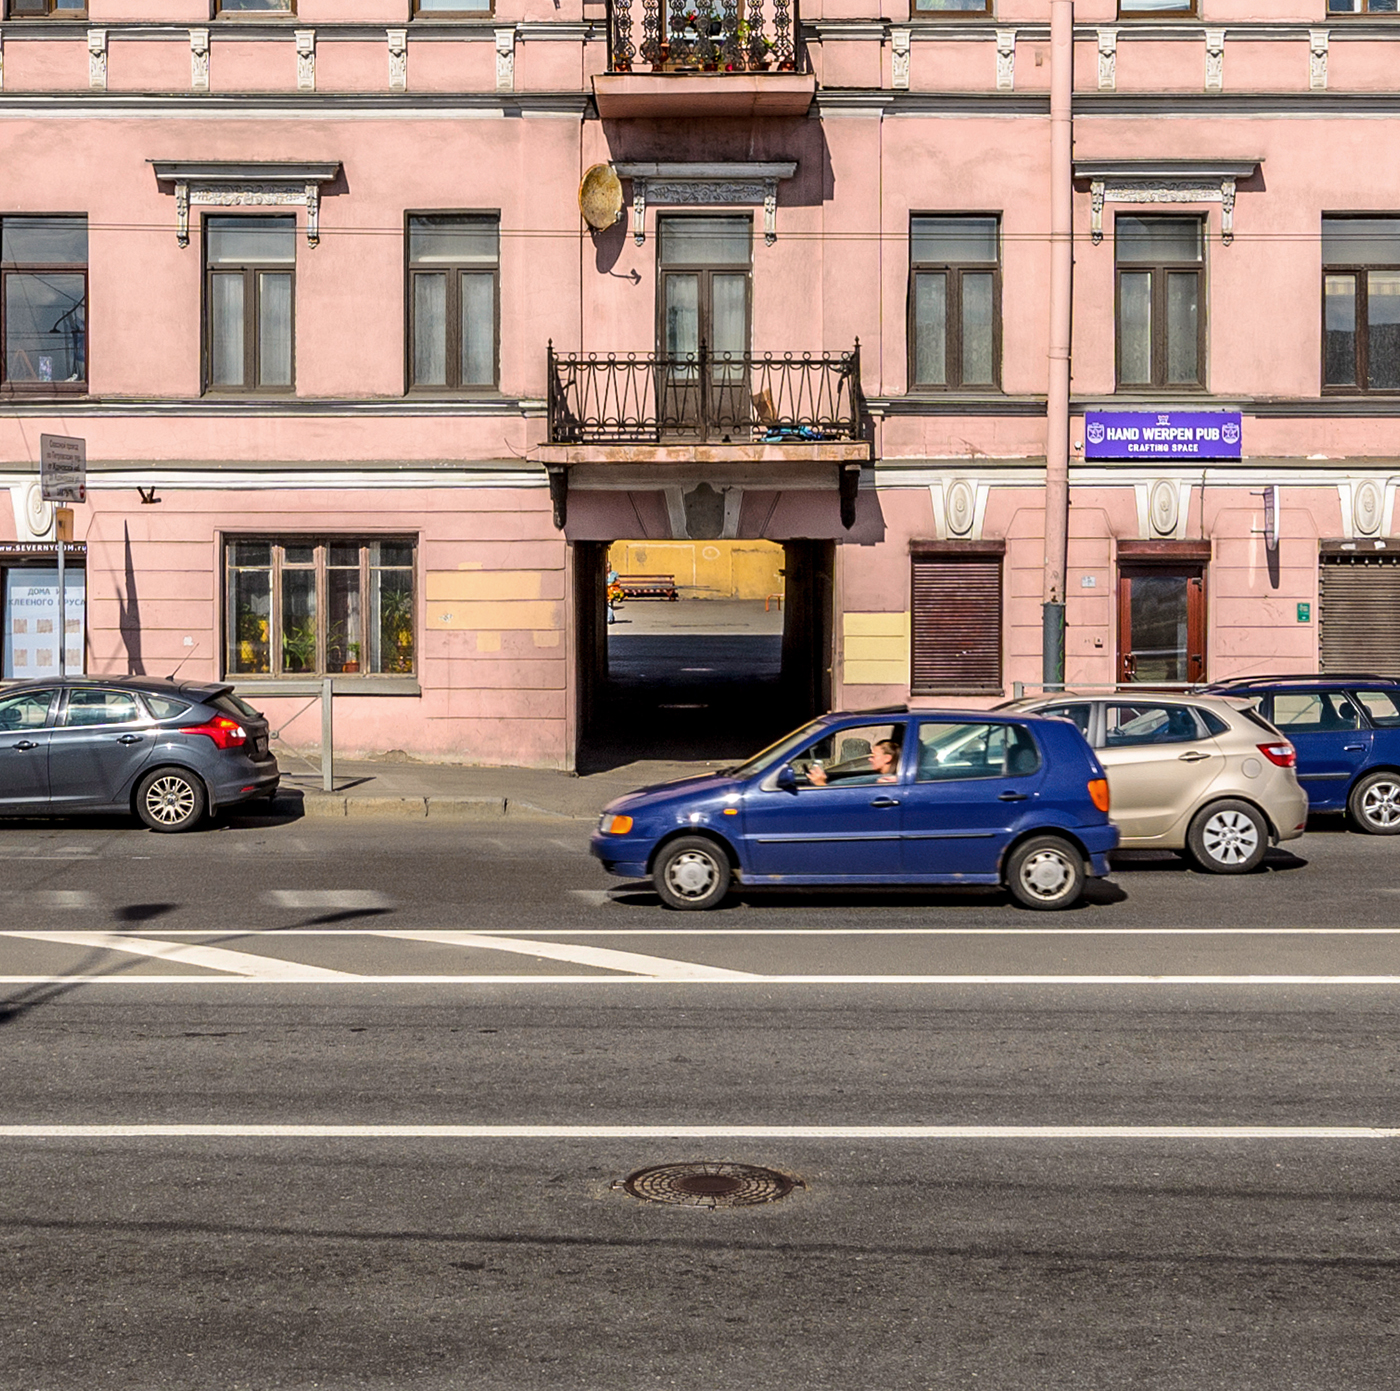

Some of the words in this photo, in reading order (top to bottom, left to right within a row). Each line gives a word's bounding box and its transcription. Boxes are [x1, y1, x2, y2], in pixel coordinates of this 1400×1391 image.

[1106, 427, 1139, 441] HAND
[1142, 427, 1193, 441] WERPEN
[1196, 427, 1220, 441] PUB
[1128, 443, 1169, 452] CRAFTING
[1171, 443, 1199, 452] SPACE
[27, 588, 51, 596] ДОМА
[8, 598, 53, 606] КЛЕЕНОГО
